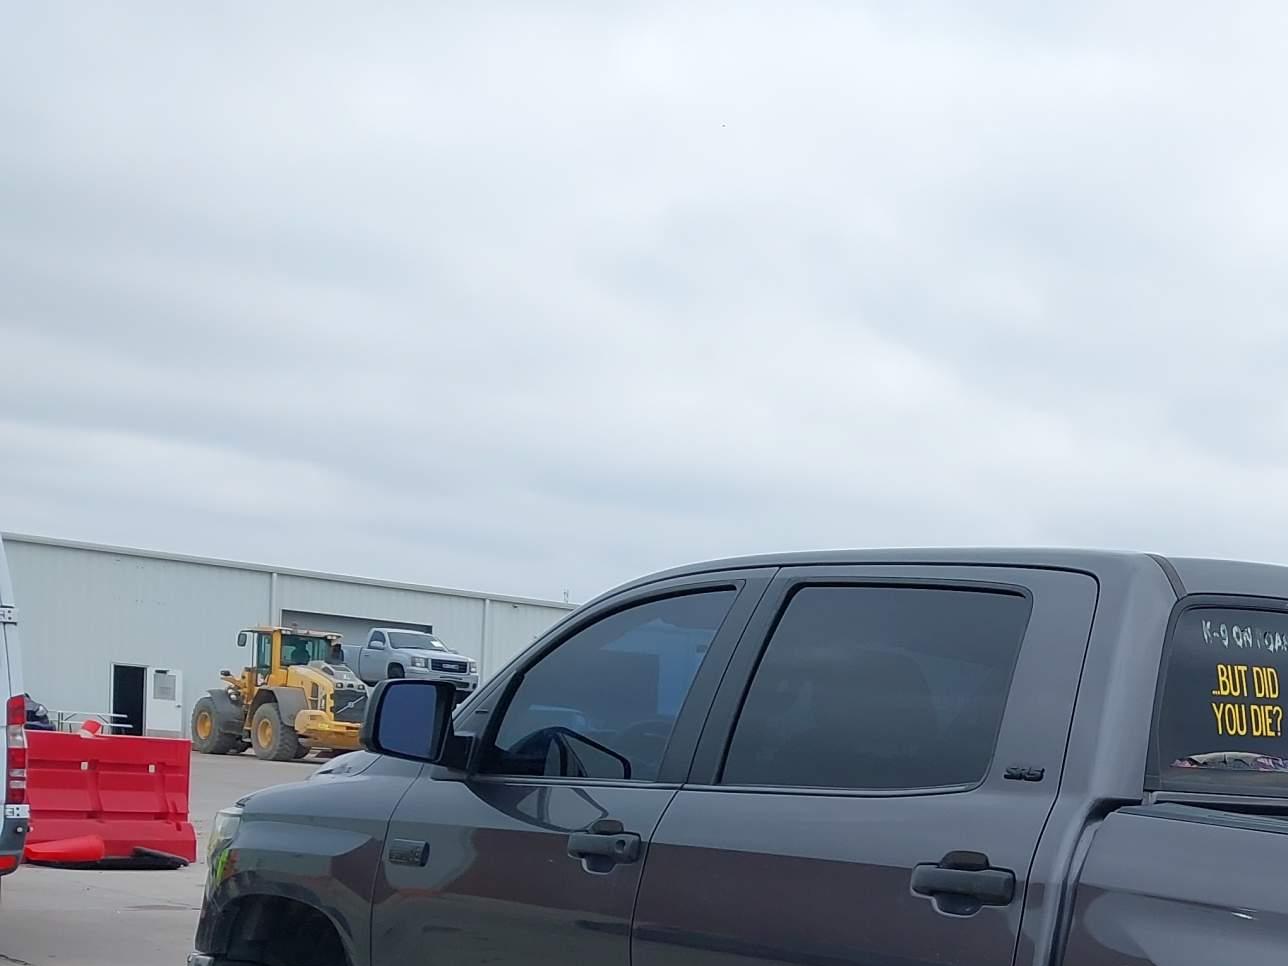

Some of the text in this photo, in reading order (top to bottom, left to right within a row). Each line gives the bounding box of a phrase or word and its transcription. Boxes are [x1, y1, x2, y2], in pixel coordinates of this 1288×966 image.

[1201, 619, 1229, 648] K-9
[1232, 625, 1253, 649] ON
[1252, 666, 1279, 698] DID
[1211, 702, 1283, 737] YOU DIE?
